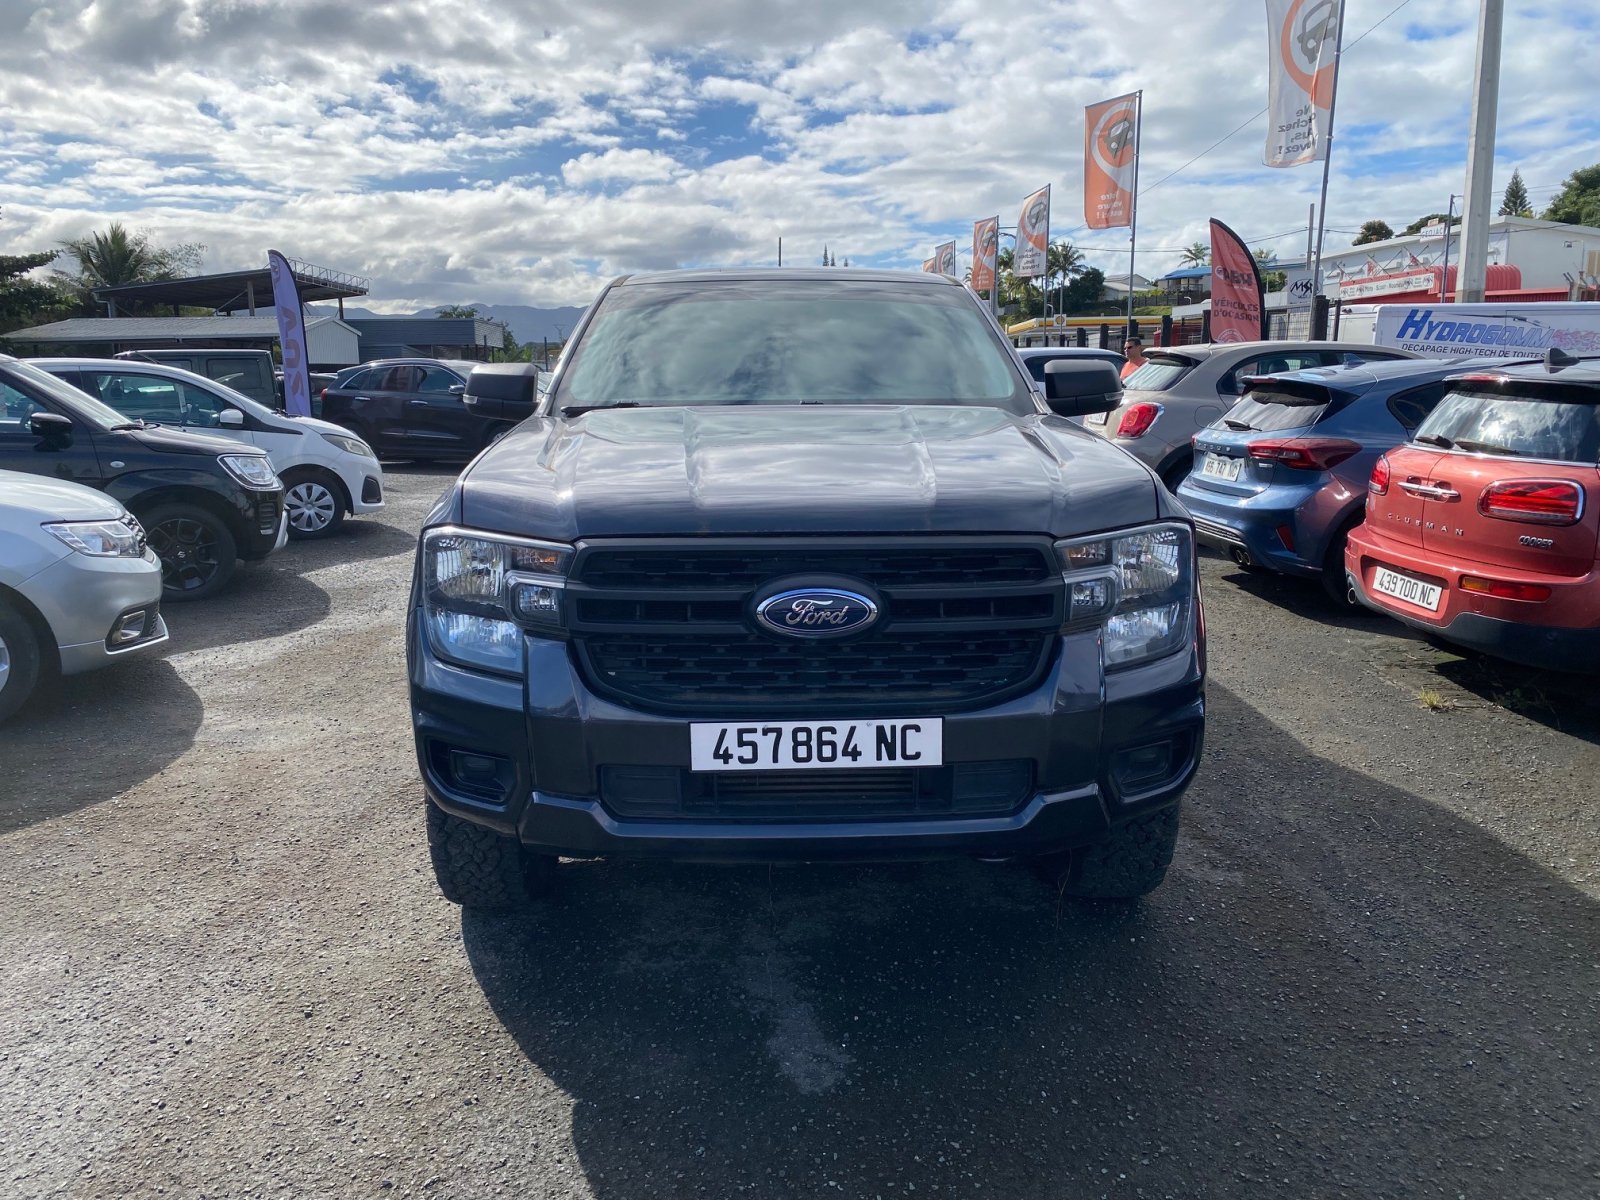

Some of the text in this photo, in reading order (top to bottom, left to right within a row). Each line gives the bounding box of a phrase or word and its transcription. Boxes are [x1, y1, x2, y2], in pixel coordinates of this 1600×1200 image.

[1401, 343, 1449, 354] DECAPAGE
[1449, 346, 1497, 358] HIGH-TECH
[1387, 512, 1464, 536] CLUBMAN
[1518, 535, 1553, 550] COOPER
[1418, 583, 1436, 606] NC
[785, 598, 849, 625] Ford
[875, 723, 922, 762] NC
